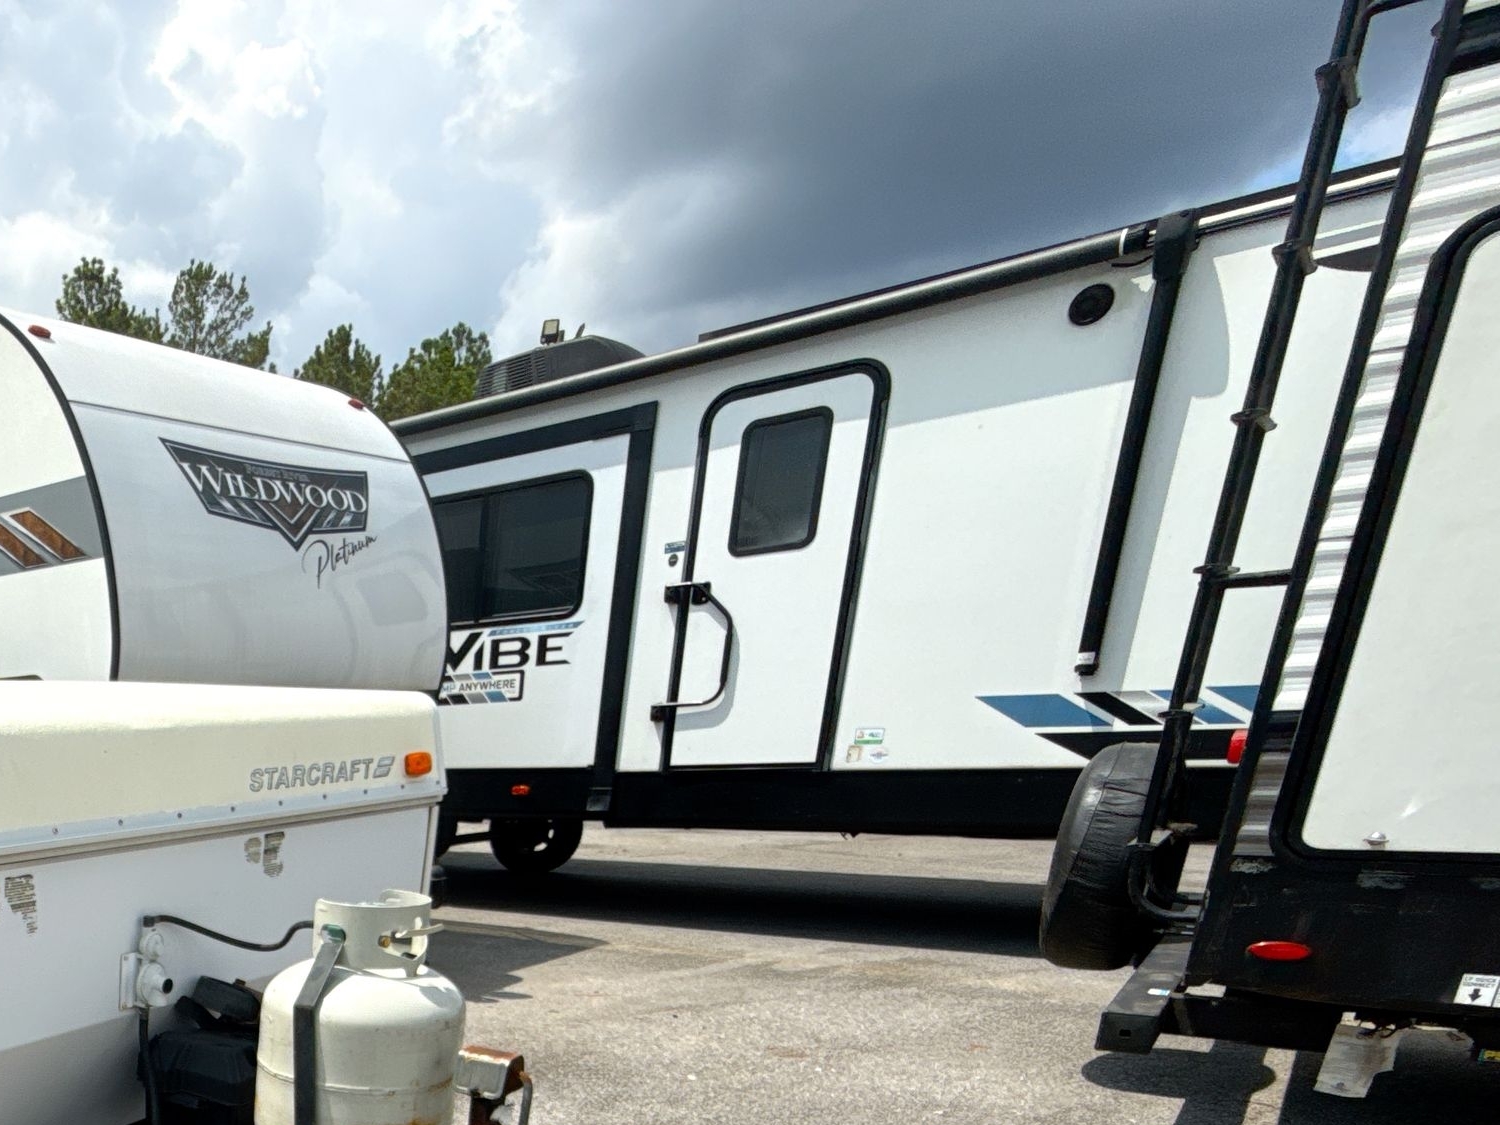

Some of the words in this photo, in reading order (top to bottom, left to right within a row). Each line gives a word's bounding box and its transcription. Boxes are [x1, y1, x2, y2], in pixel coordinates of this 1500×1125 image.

[180, 462, 368, 513] WILDWOOD
[301, 535, 377, 589] Platinum
[459, 678, 517, 692] ANYWHERE
[249, 758, 374, 793] STARCRAFT
